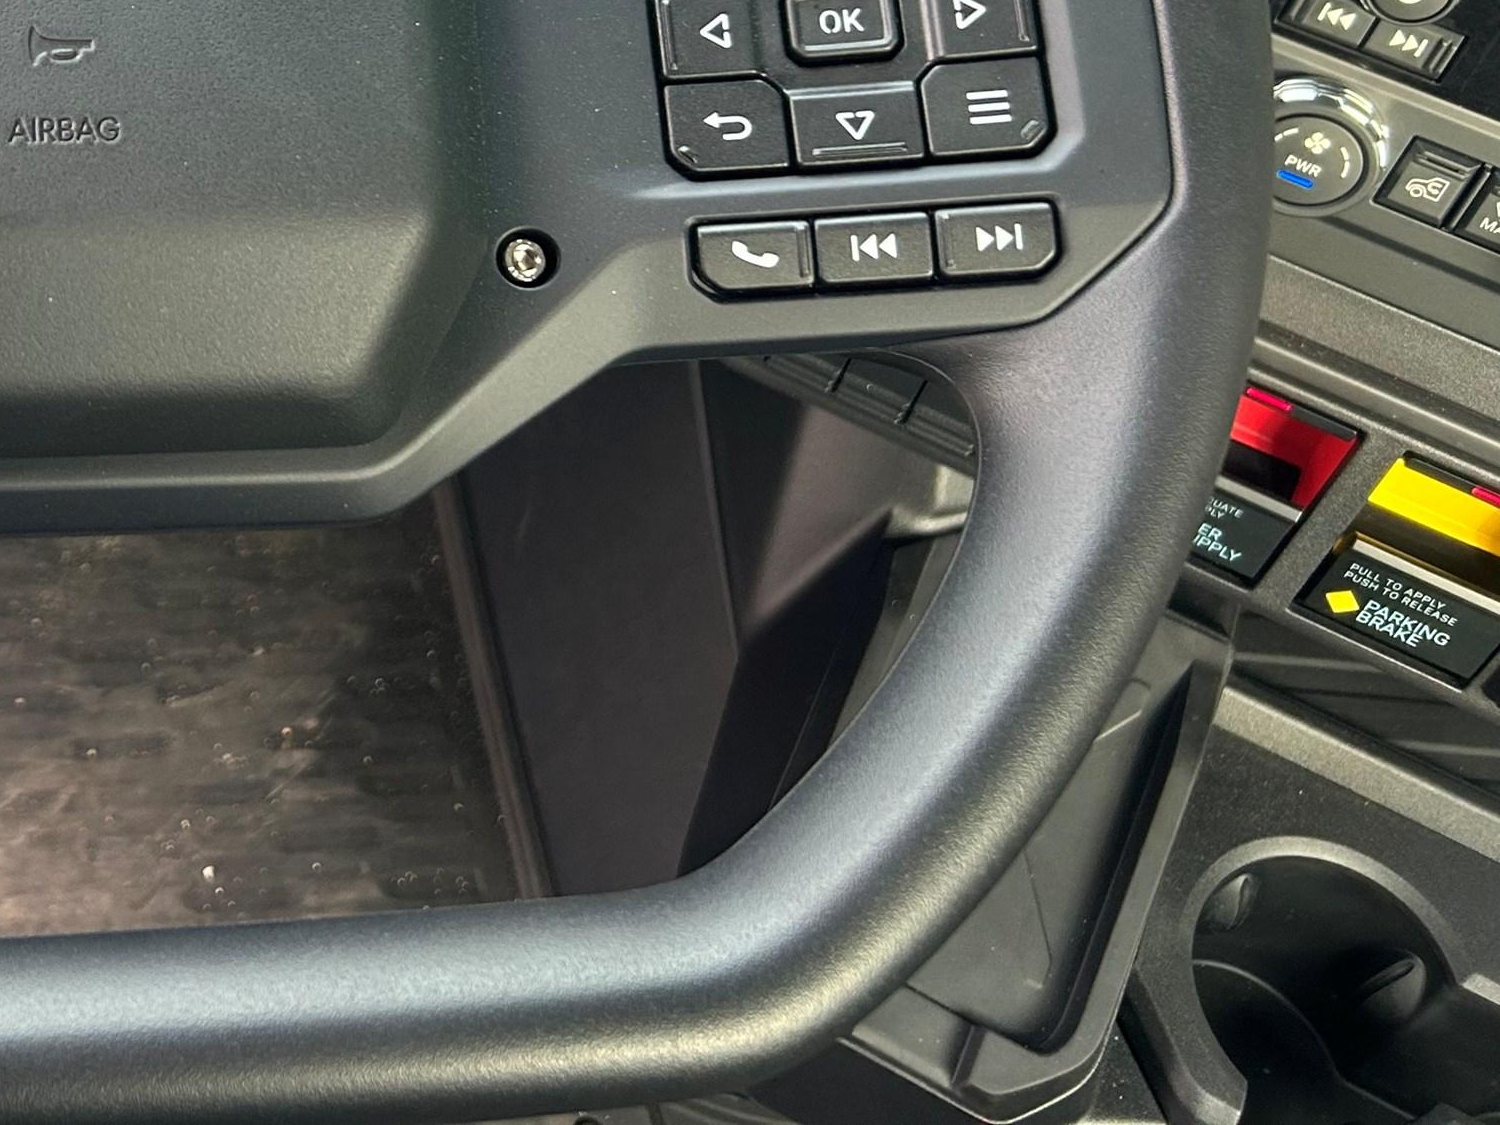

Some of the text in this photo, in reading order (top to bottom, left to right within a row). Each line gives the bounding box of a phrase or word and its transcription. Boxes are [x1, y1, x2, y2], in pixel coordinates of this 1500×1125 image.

[818, 7, 865, 35] OK
[8, 115, 122, 145] AIRBAG
[1284, 154, 1322, 178] PWR
[1343, 570, 1458, 626] PUSH TO RELEASE
[1350, 563, 1446, 610] PULL TO APPLY
[1355, 610, 1423, 647] BRAKE
[1363, 599, 1451, 646] PARKING
